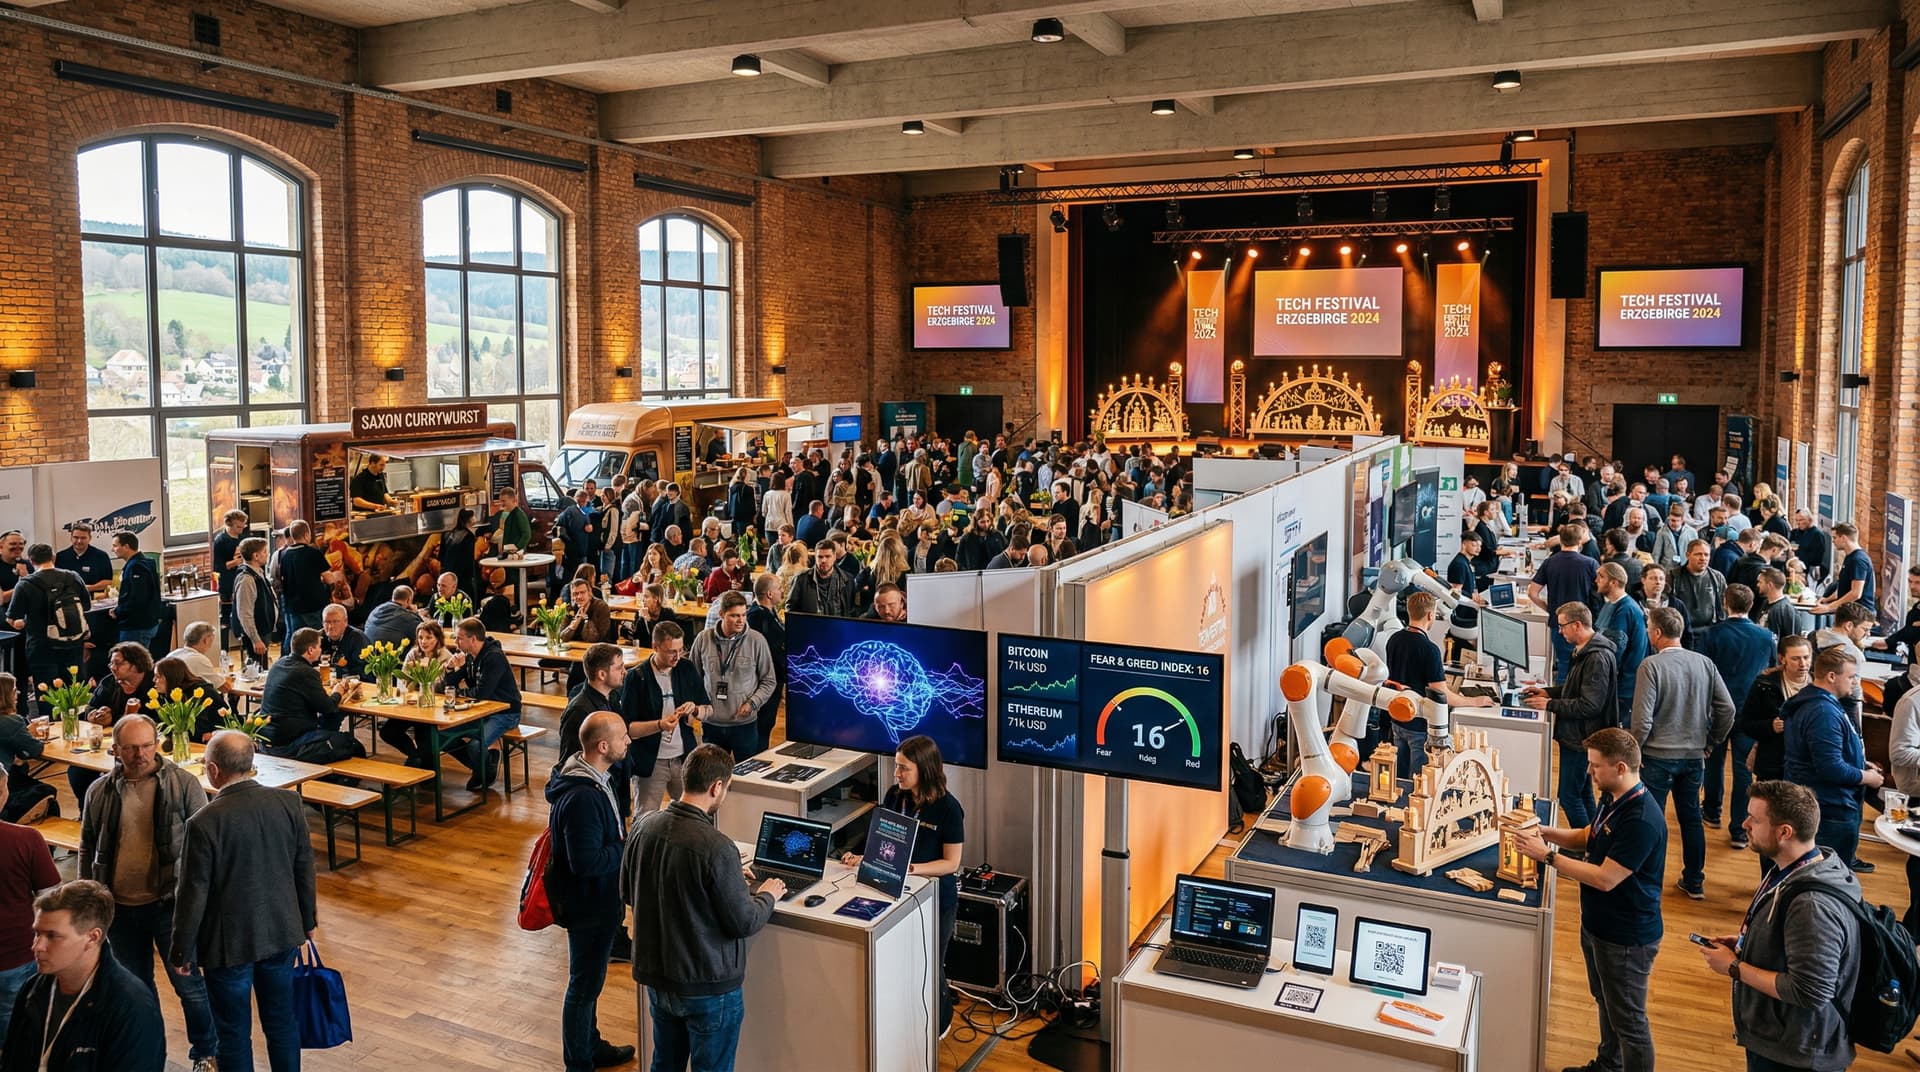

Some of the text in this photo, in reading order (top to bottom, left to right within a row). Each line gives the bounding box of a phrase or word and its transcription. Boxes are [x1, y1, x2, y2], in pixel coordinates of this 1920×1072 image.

[1276, 296, 1380, 311] TECH FESTIVAL
[1620, 293, 1722, 307] TECH FESTIVAL
[927, 304, 995, 316] TECH FESTIVAL
[1192, 308, 1219, 318] TECH
[1442, 304, 1472, 314] TECH
[1620, 307, 1721, 320] ERZGEBIRGE 2024
[927, 316, 996, 326] ERZGEBIRGE 2024
[1276, 312, 1380, 325] ERZGEBIRGE 2024
[1194, 330, 1216, 339] 2024
[1444, 326, 1469, 337] 2024
[361, 409, 480, 430] SAXON CURRYWURST
[1008, 645, 1049, 660] BITCOIN
[1008, 660, 1047, 674] 71k USD
[1091, 654, 1210, 676] FEAR & GREED INDEX: 16
[1008, 703, 1063, 720] ETHEREUM
[1008, 716, 1047, 731] 71k USD
[1132, 723, 1165, 750] 16
[1096, 748, 1112, 757] Fear
[1186, 759, 1200, 769] Red
